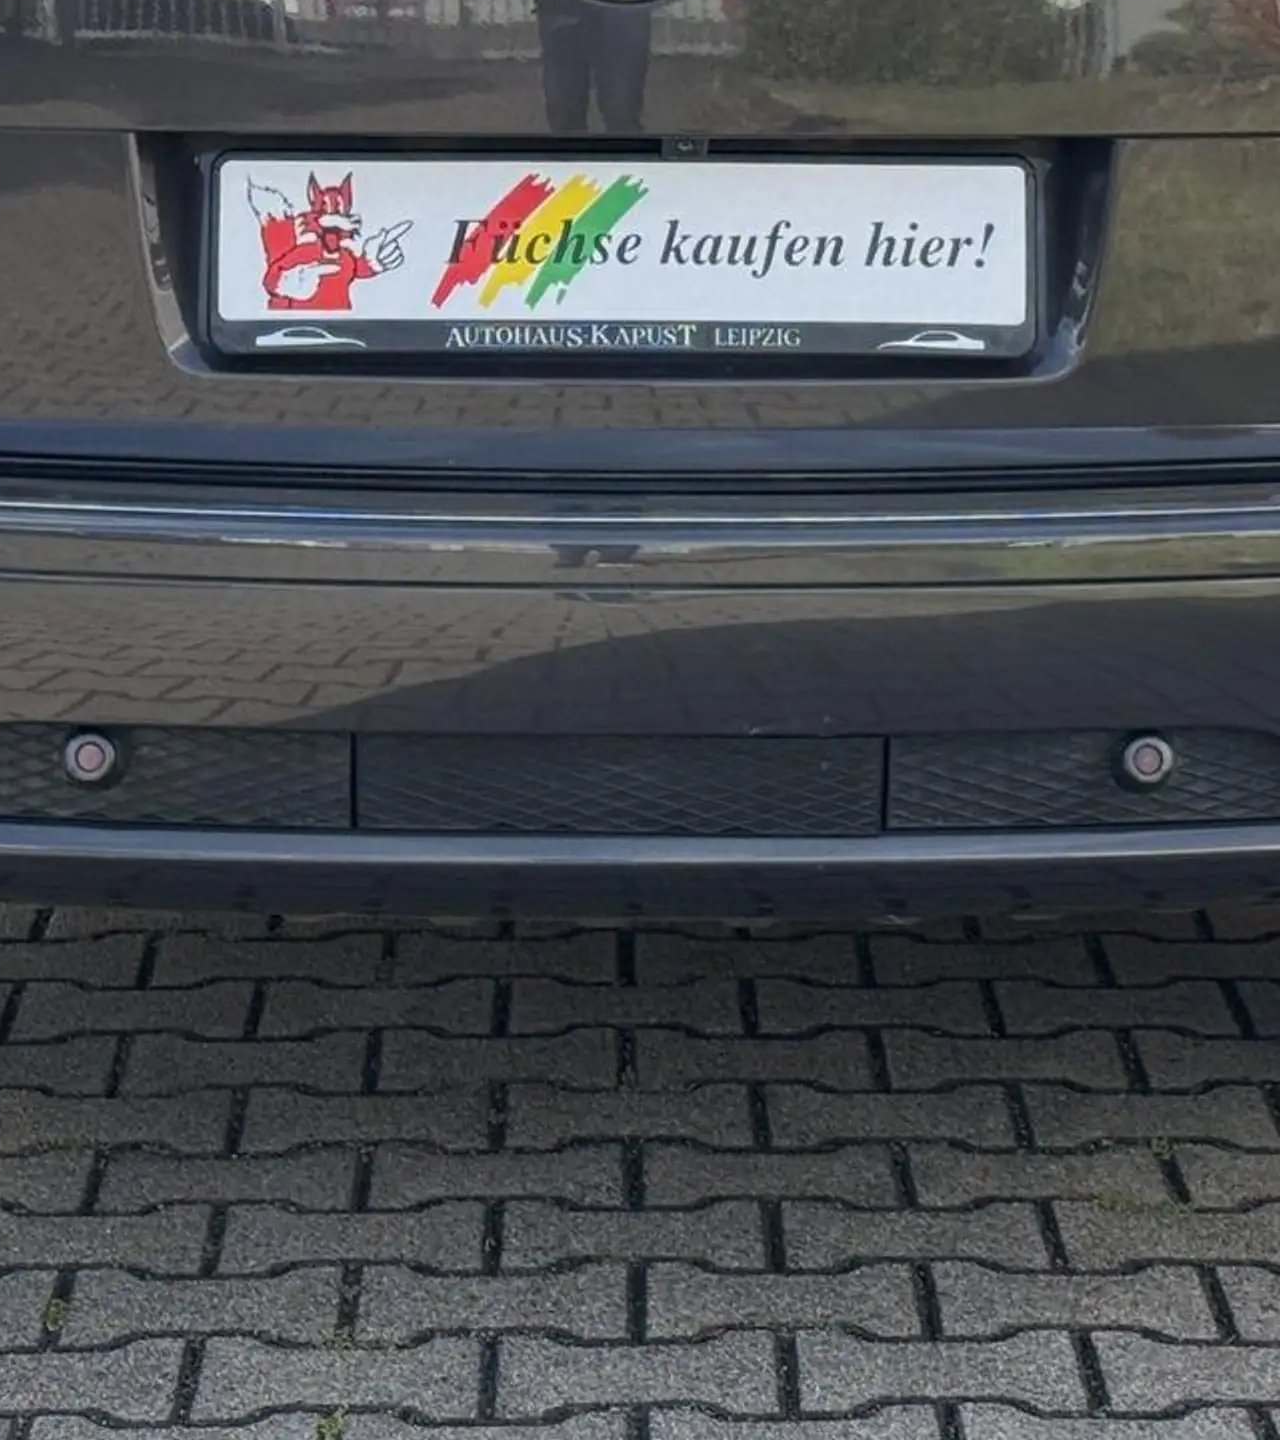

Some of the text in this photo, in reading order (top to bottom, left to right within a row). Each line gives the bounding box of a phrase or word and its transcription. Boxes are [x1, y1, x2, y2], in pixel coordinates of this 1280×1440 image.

[445, 218, 996, 280] Füchse kaufen hier!
[714, 326, 802, 348] LEIPZIG
